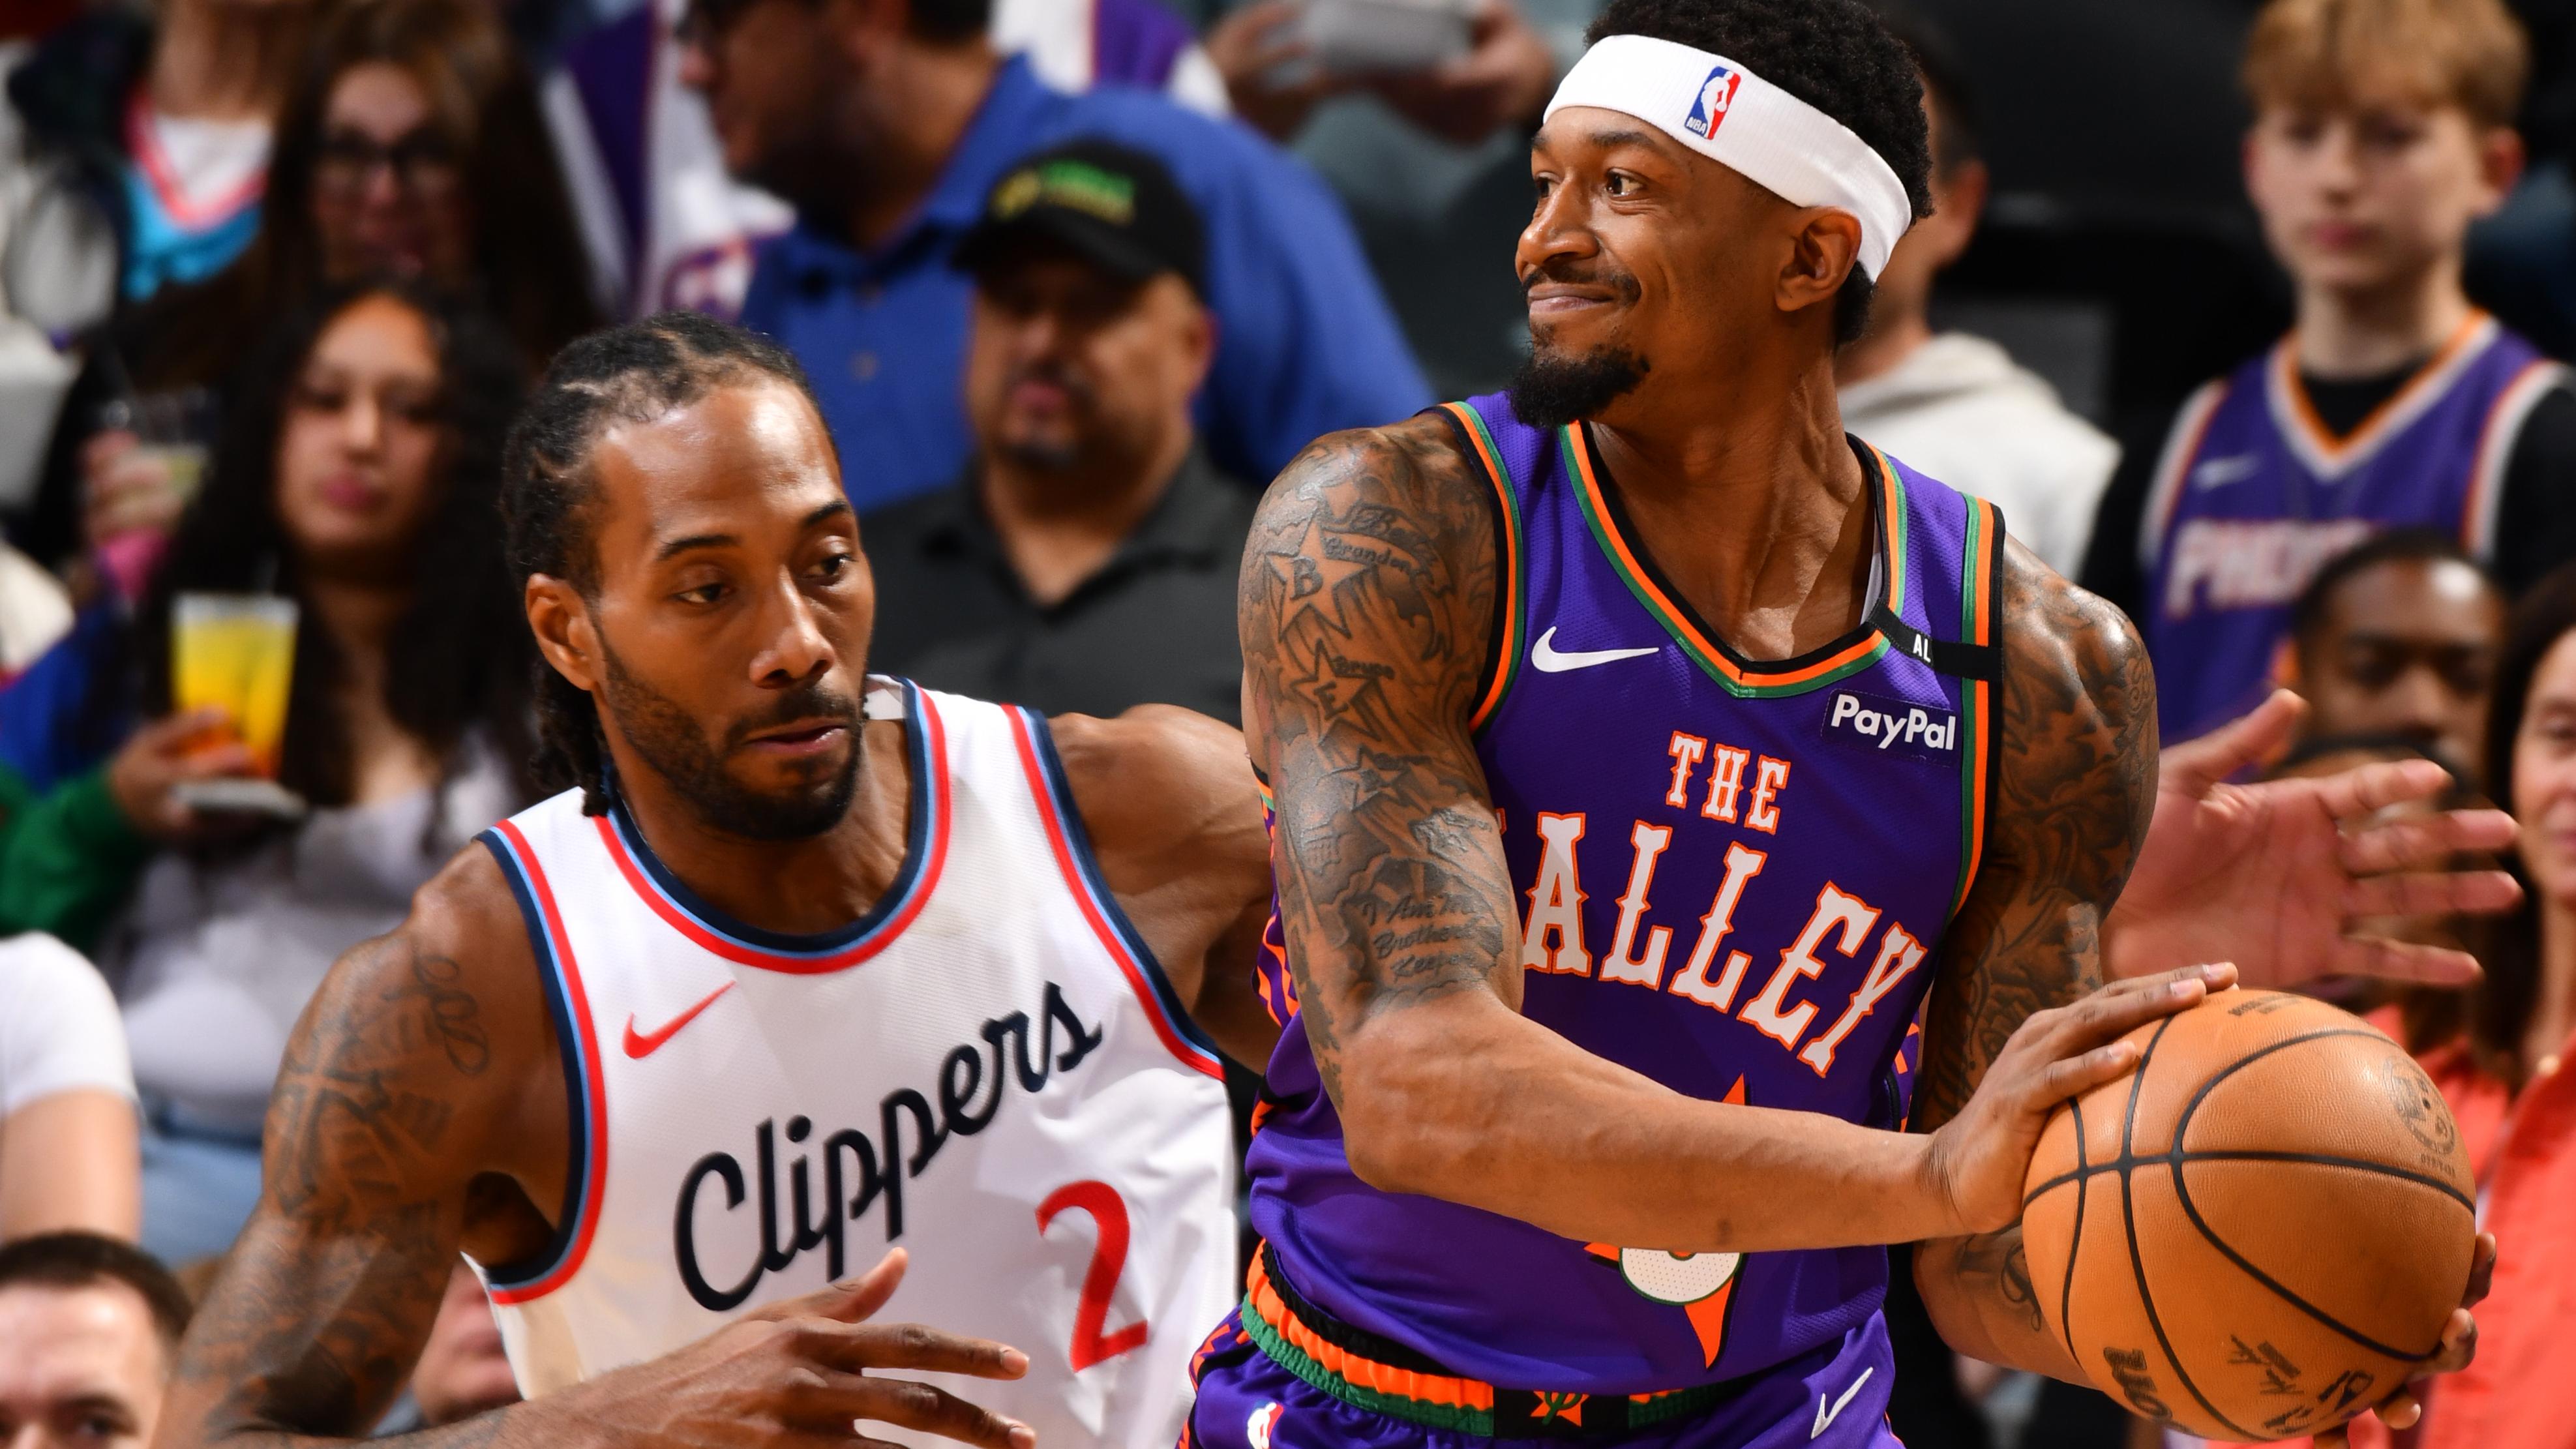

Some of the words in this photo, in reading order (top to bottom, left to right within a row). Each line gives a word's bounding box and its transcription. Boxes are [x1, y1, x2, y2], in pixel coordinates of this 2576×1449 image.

[1686, 117, 1707, 134] NBA
[1290, 556, 1323, 600] B
[1913, 634, 1931, 663] AL
[1831, 694, 1956, 751] PayPal
[1666, 730, 1791, 835] THE
[1495, 808, 1928, 1079] ALLEY
[673, 980, 1102, 1312] Clippers
[1035, 1180, 1148, 1373] 2
